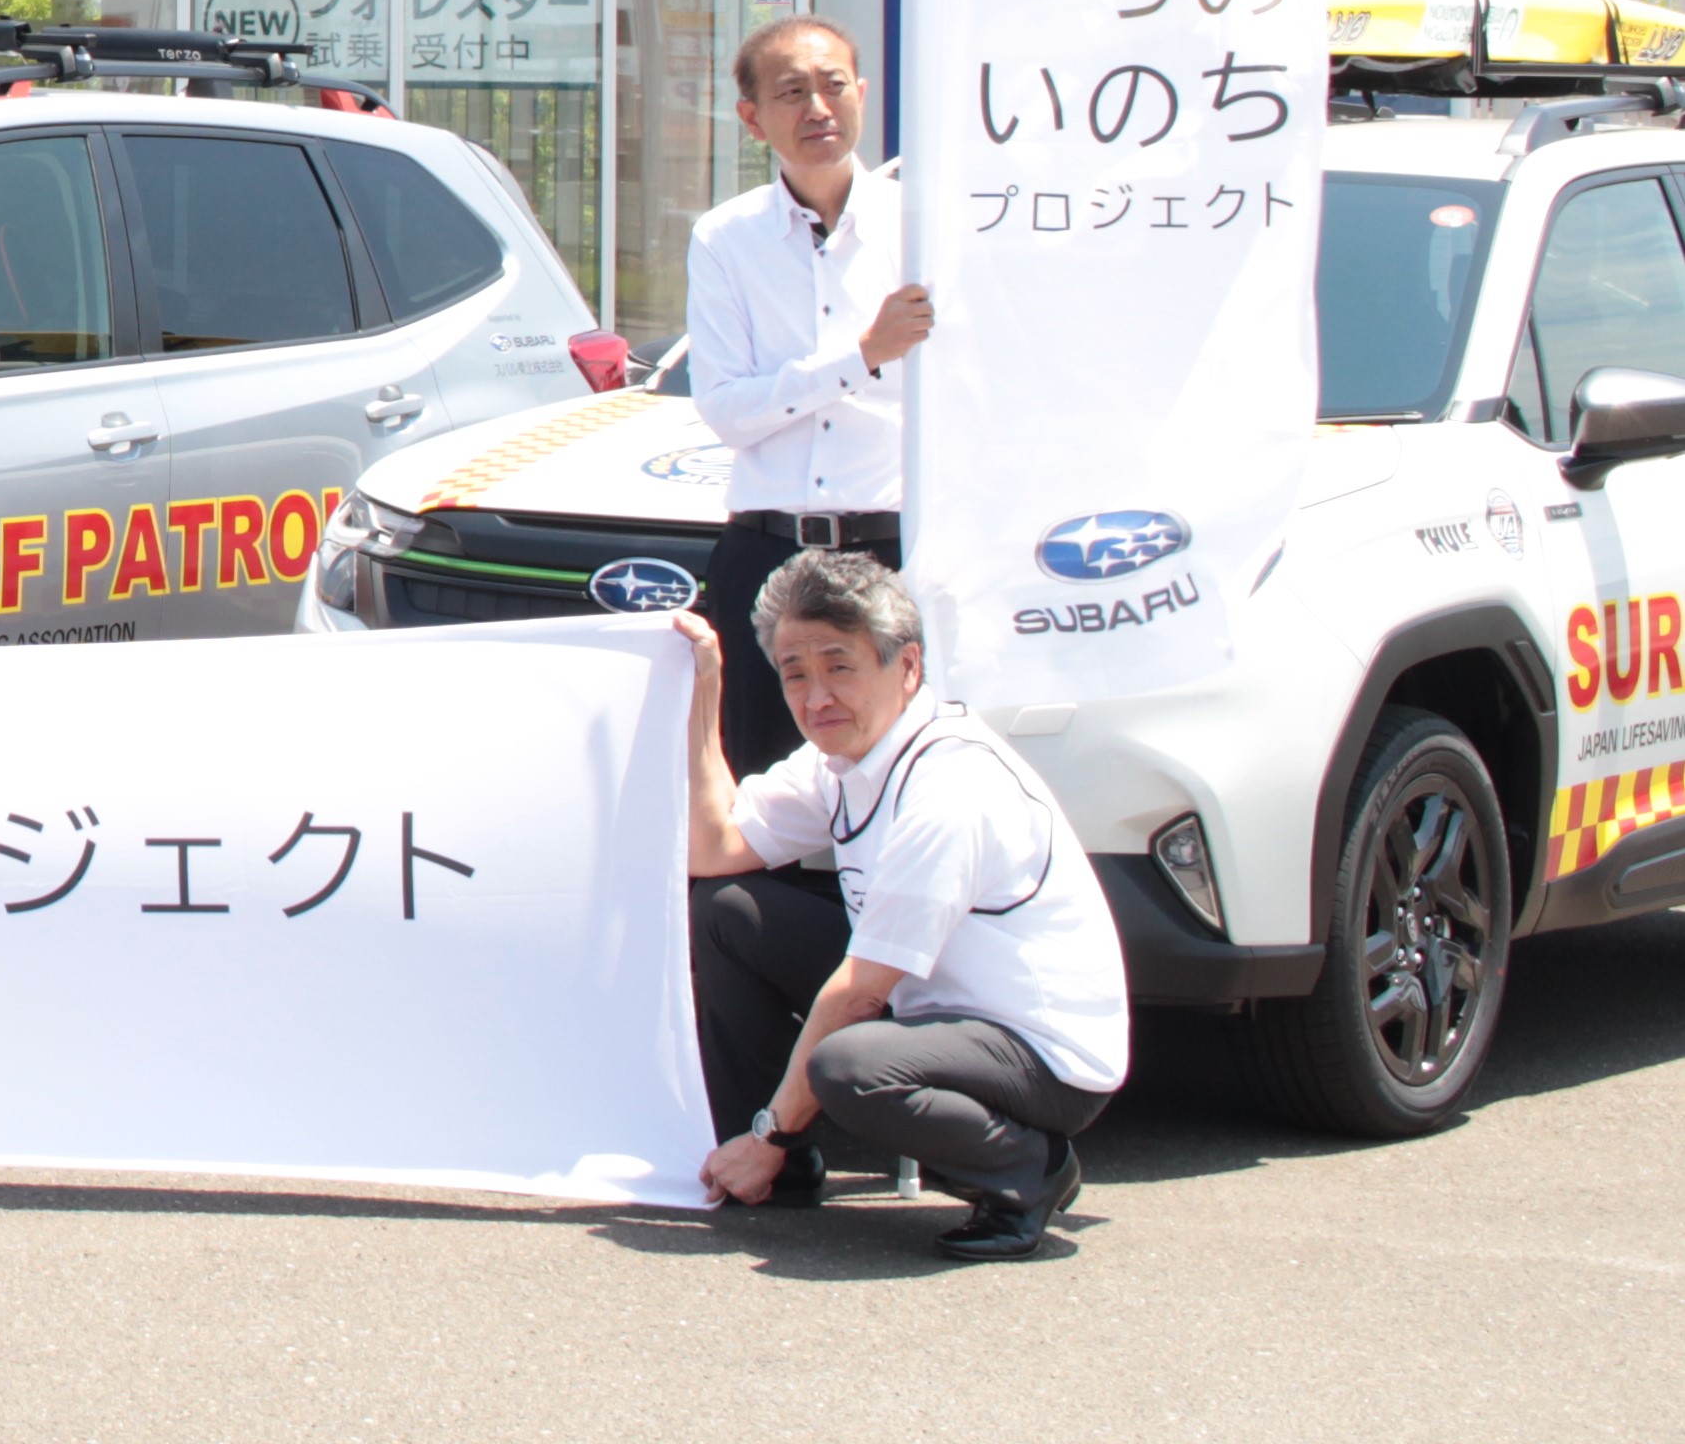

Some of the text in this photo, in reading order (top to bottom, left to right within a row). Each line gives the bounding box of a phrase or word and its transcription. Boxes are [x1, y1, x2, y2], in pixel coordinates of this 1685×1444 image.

[214, 10, 291, 36] NEW
[305, 34, 531, 71] 試乗受付中
[979, 49, 1290, 148] いのち
[969, 181, 1294, 233] プロジェクト
[513, 335, 556, 348] SUBARU
[1415, 521, 1479, 556] THULE
[1014, 572, 1200, 635] SUBARU
[1577, 714, 1685, 762] JAPAN LIFESAVIN
